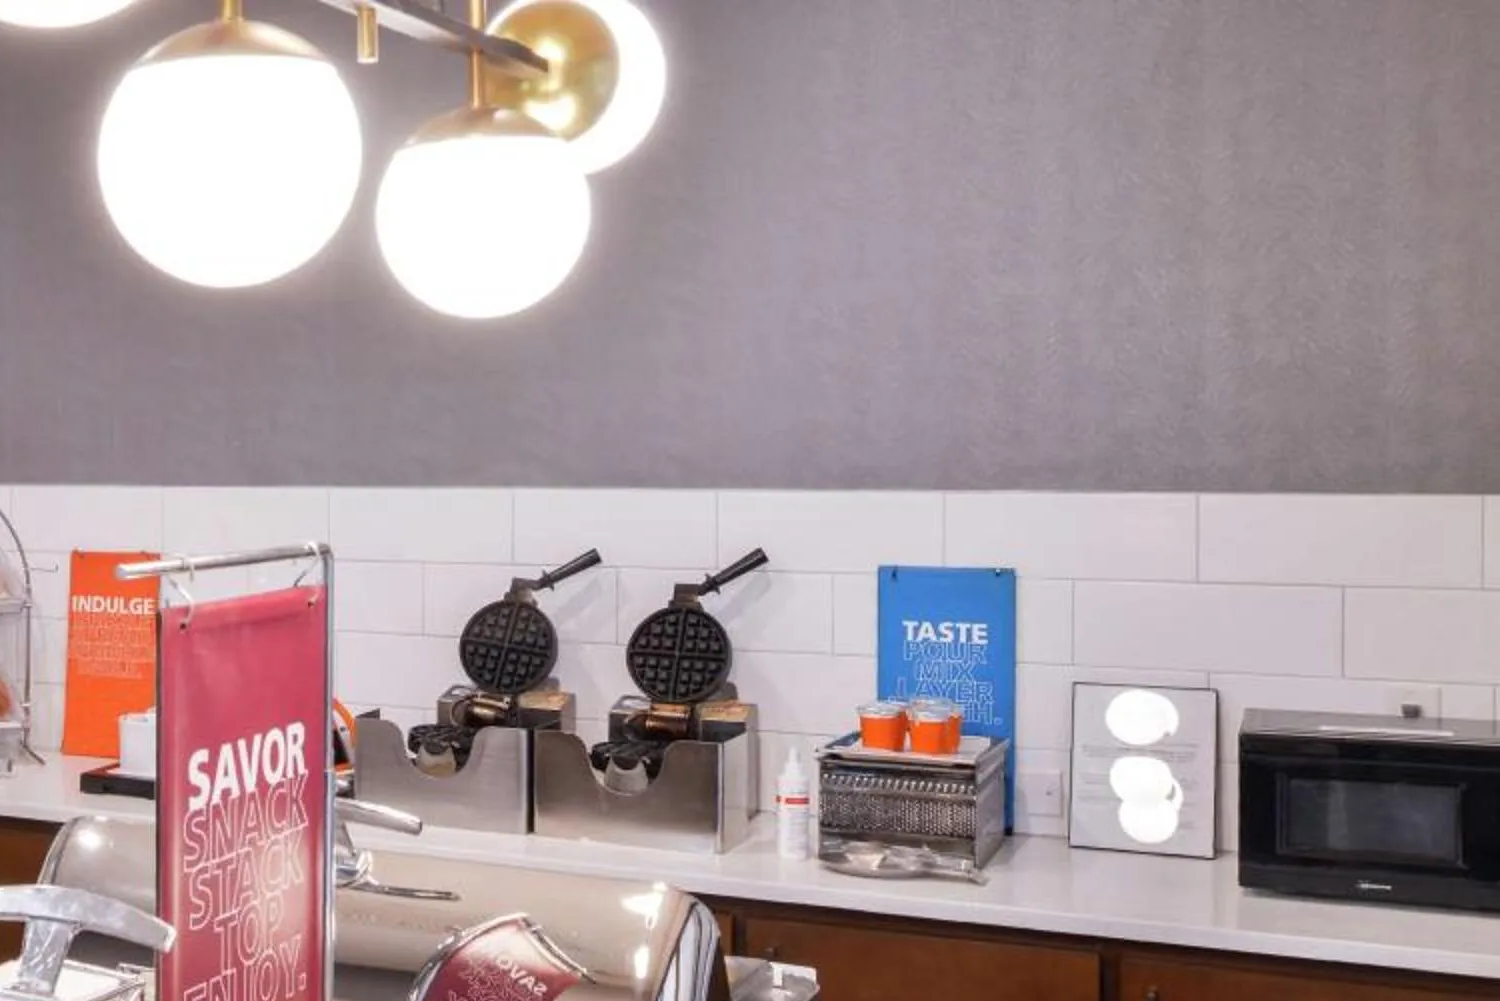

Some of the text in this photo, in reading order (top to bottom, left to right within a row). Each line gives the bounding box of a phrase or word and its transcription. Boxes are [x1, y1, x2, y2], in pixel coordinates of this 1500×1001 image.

[71, 595, 156, 615] INDULGE
[902, 620, 989, 645] TASTE
[903, 640, 988, 664] POUR
[916, 659, 975, 682] MIX
[188, 721, 306, 812] SAVOR
[184, 769, 309, 872] SNACK
[189, 824, 305, 931] STACK
[213, 891, 283, 976] TOP
